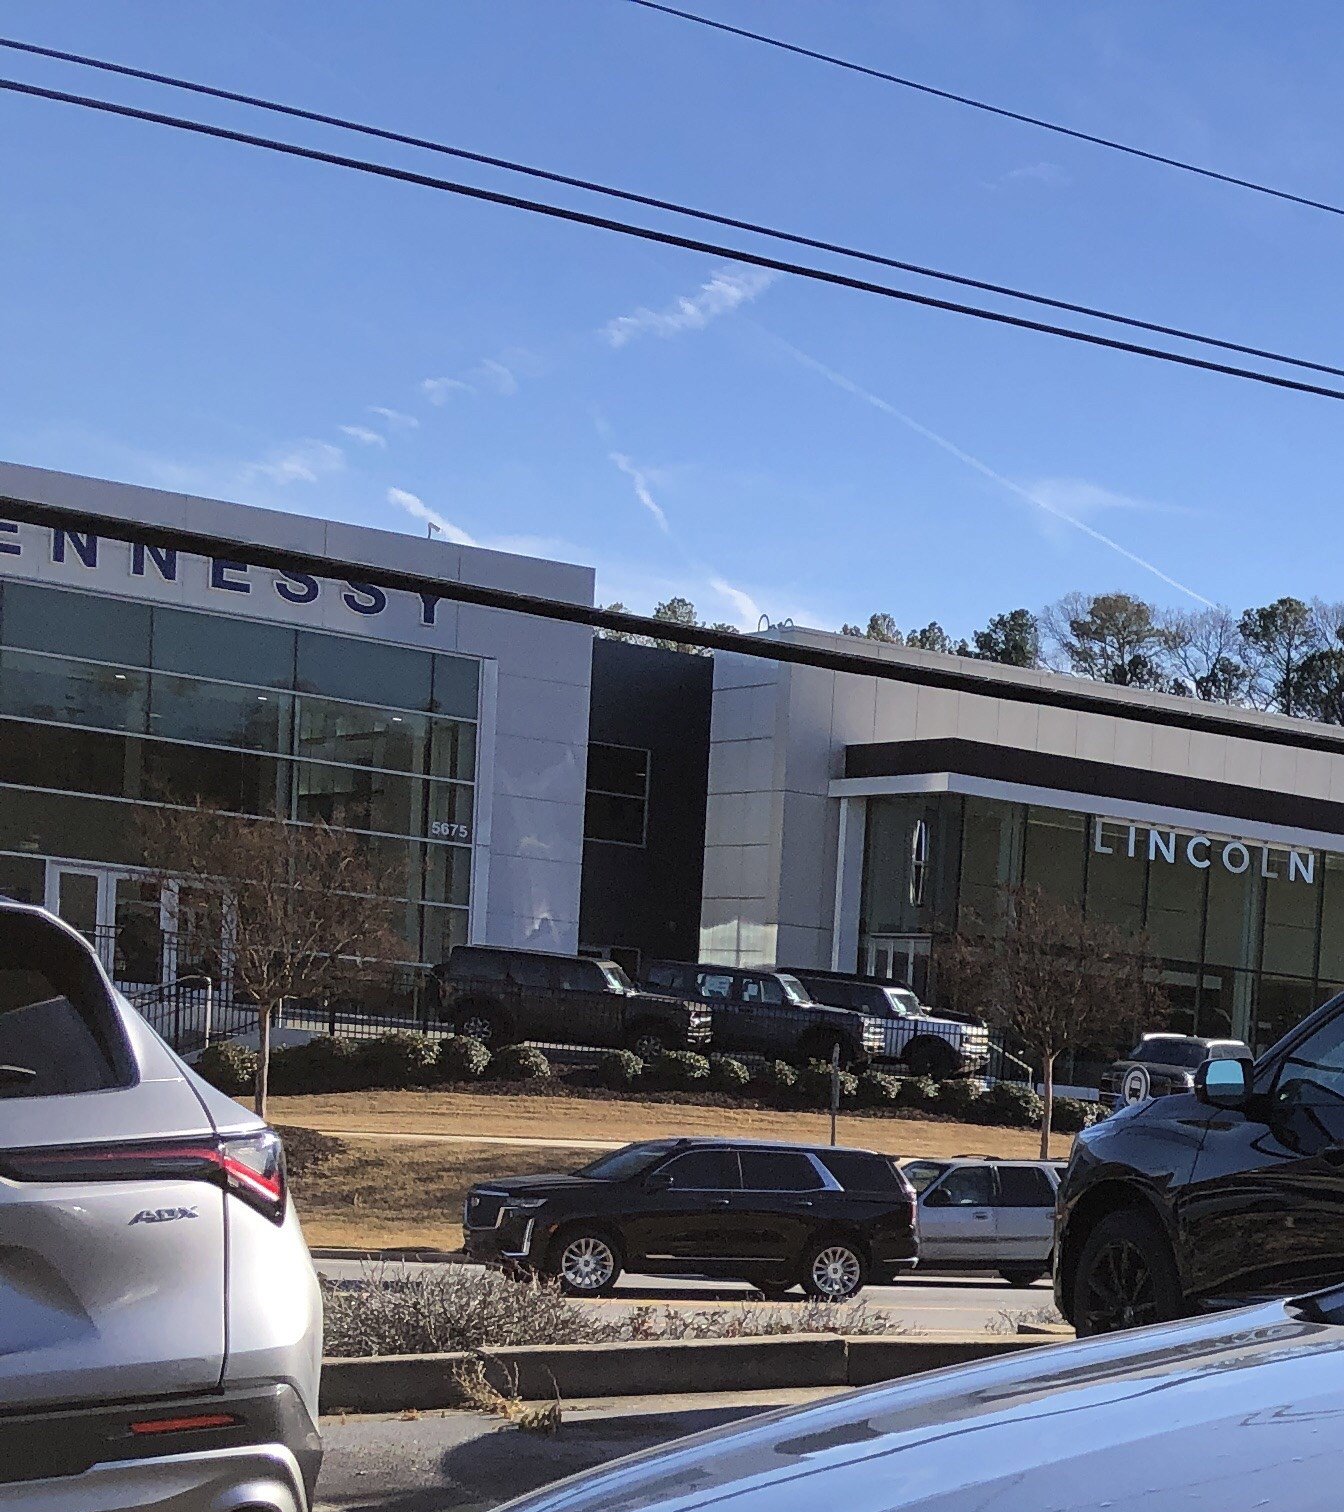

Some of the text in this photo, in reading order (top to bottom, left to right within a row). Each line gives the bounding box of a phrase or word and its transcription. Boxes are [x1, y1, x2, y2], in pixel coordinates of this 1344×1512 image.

[432, 821, 468, 838] 5675
[1095, 817, 1315, 884] LINCOLN
[128, 1206, 199, 1226] ADX
